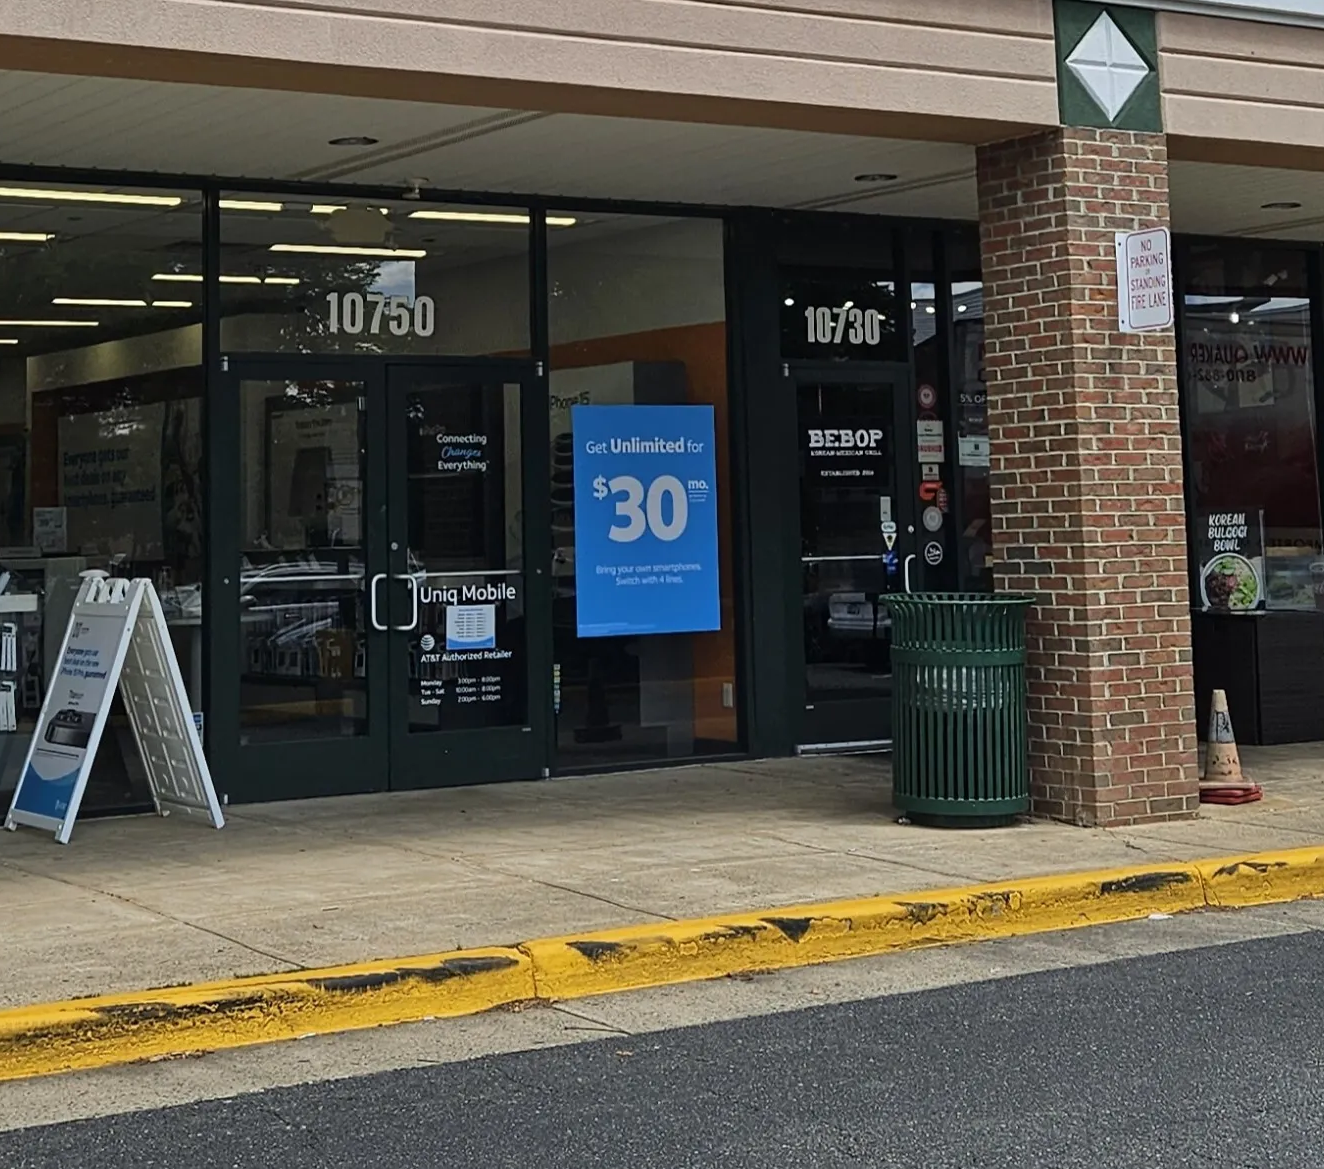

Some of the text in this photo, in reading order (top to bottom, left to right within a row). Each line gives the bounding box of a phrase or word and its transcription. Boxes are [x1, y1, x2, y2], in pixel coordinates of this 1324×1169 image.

[1140, 239, 1152, 252] NO
[1130, 252, 1165, 269] PARKING
[1130, 275, 1166, 292] STANDING
[1131, 291, 1167, 311] FIRE LANE
[326, 292, 435, 337] 10750
[804, 306, 881, 345] 10730
[975, 394, 986, 403] OF
[436, 434, 487, 445] Connecting
[586, 436, 704, 454] Get Unlimited for
[808, 429, 883, 448] BEBOP
[437, 460, 487, 472] Everything
[593, 474, 709, 543] $30 mo.
[1208, 512, 1246, 527] KOREAN
[1208, 526, 1248, 539] BULGOGI
[1213, 539, 1241, 552] BOWL
[596, 565, 616, 575] Bring
[616, 566, 635, 576] your
[616, 576, 640, 586] Switch
[641, 575, 658, 585] with
[420, 582, 516, 607] Uniq Mobile
[420, 650, 512, 663] AT&T Authorized Retailer
[420, 680, 442, 688] Monday
[420, 698, 441, 706] Sunday
